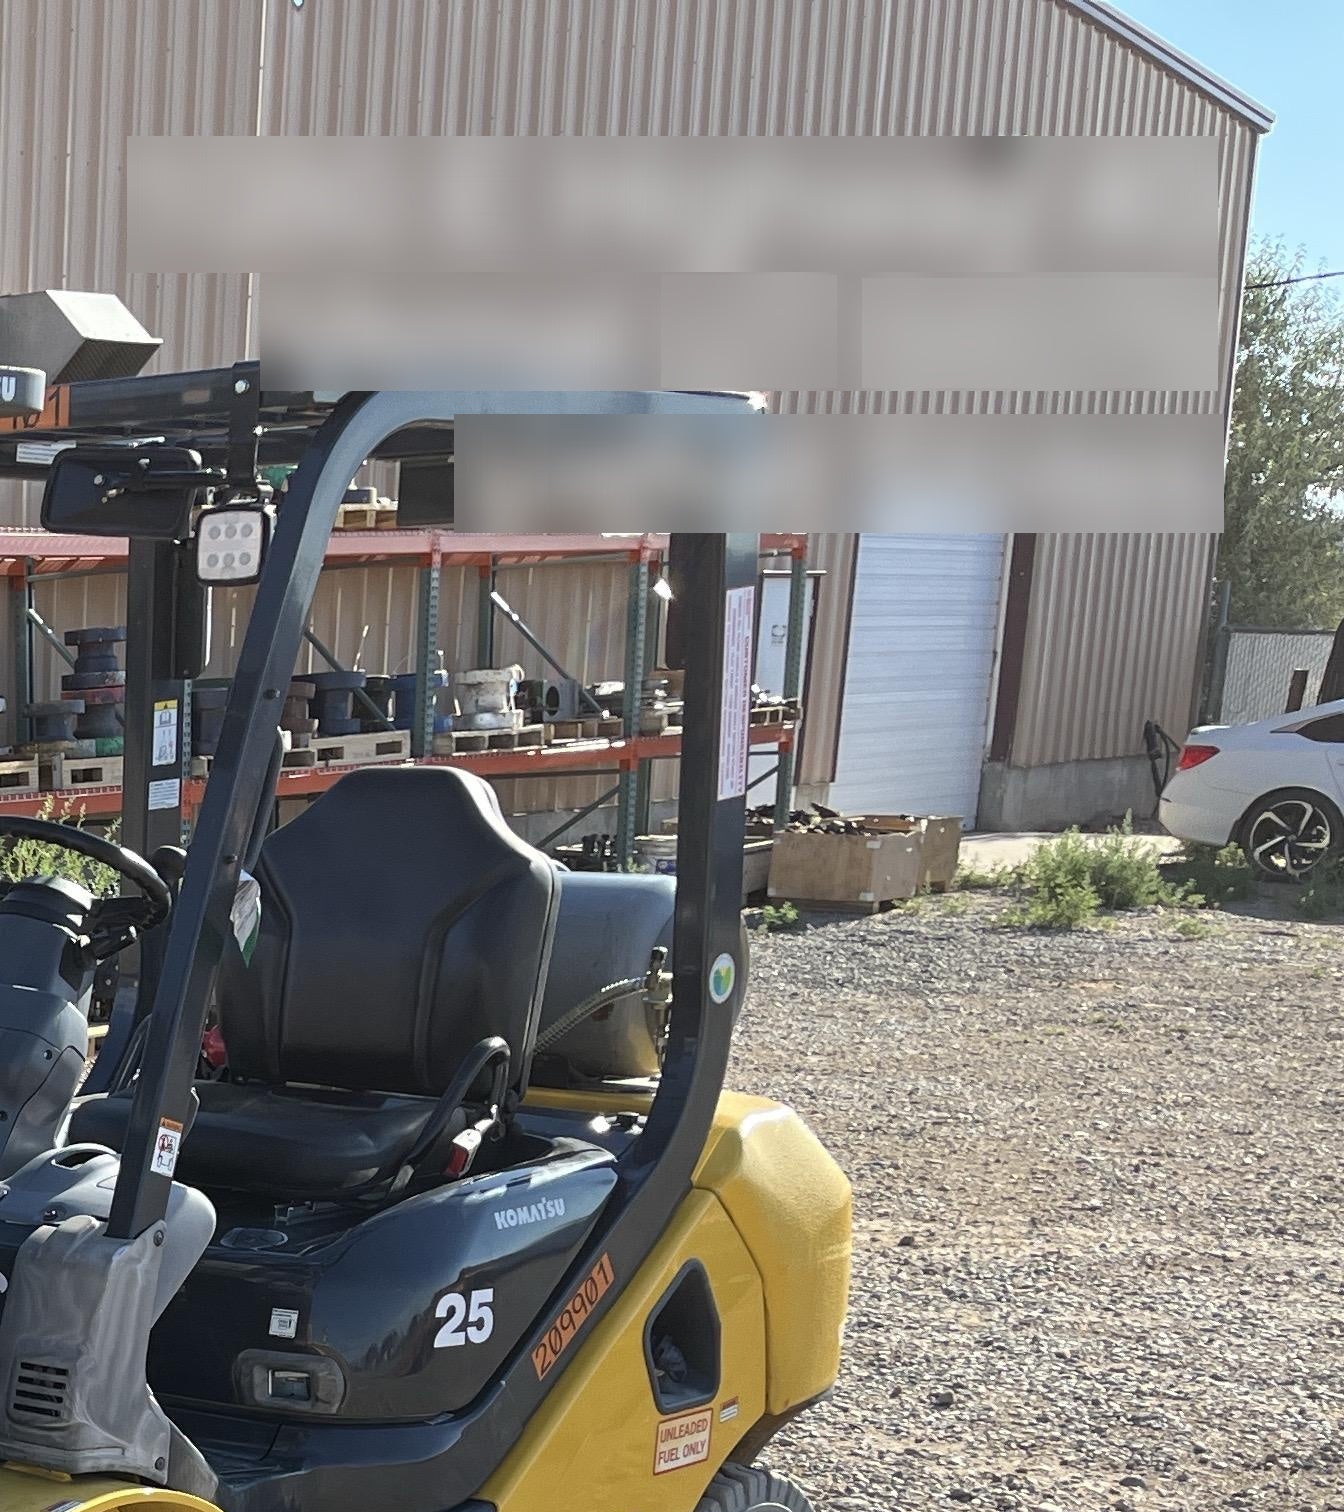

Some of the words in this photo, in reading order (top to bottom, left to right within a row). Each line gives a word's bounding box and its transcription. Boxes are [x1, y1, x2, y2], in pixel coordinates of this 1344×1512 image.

[494, 1197, 566, 1230] KOMATSU
[433, 1287, 494, 1349] 25
[535, 1262, 611, 1377] 209901
[660, 1418, 709, 1443] UNLEADED
[657, 1447, 681, 1466] FUEL
[682, 1439, 707, 1458] ONLY
